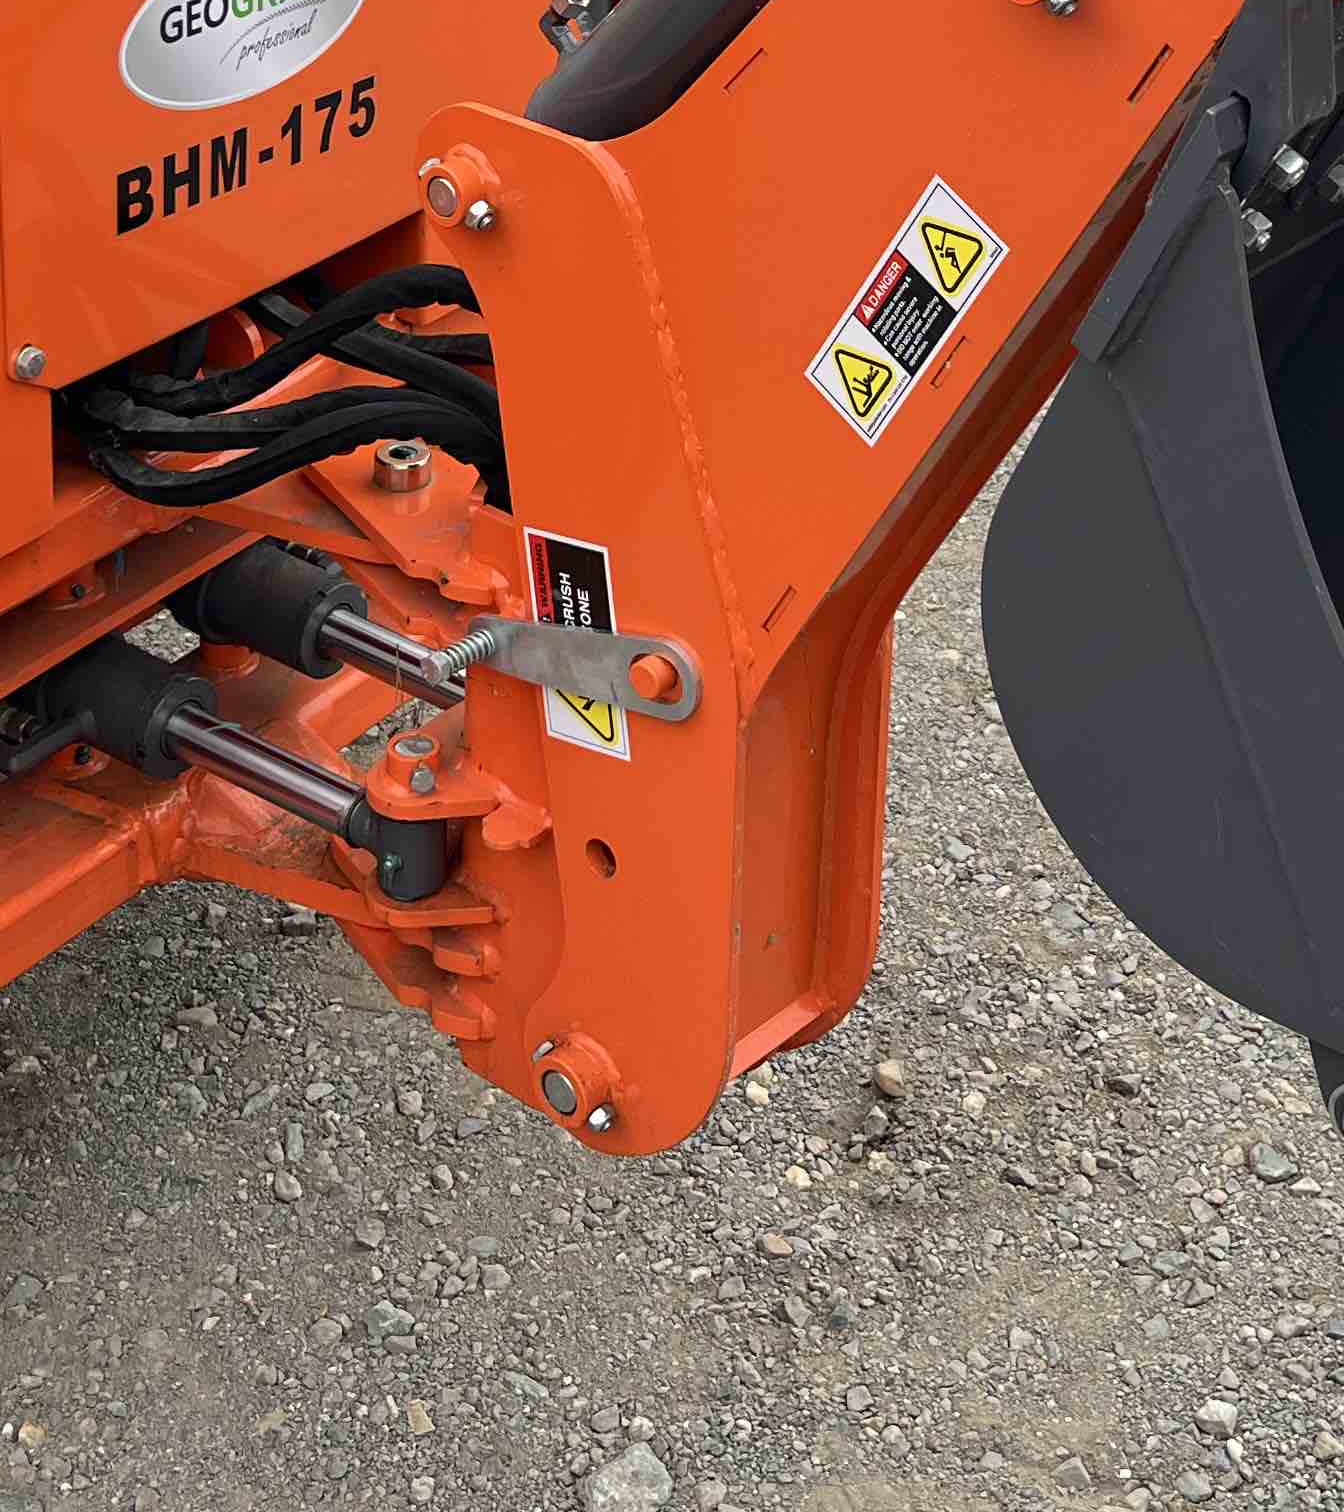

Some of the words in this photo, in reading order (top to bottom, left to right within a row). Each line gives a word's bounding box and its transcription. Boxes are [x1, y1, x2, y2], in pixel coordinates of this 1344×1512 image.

[236, 8, 318, 73] professional
[116, 75, 376, 237] BHM-175
[868, 261, 902, 305] DANGER
[558, 572, 576, 631] CRUSH
[577, 588, 593, 630] ONE
